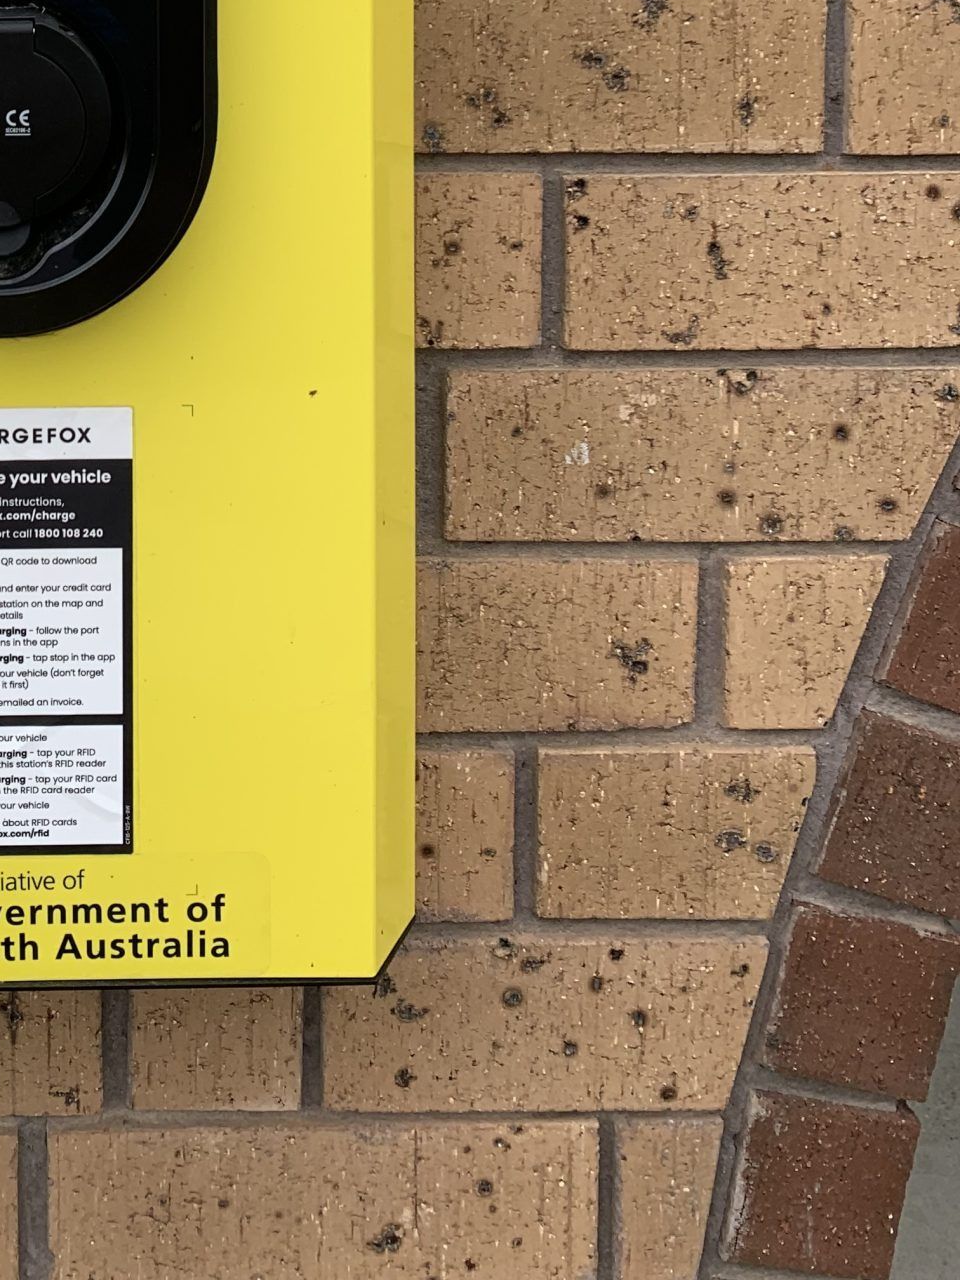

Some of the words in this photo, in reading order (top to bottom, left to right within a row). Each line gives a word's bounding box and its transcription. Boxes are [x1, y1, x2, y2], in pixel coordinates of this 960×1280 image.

[5, 109, 30, 126] CE
[10, 472, 48, 488] your
[52, 470, 112, 484] vehicle
[0, 497, 64, 508] instructions,
[13, 529, 32, 538] call
[34, 529, 60, 538] 1800
[62, 529, 80, 538] 108
[83, 528, 103, 538] 240
[1, 557, 13, 566] QR
[16, 557, 38, 565] code
[41, 557, 50, 565] to
[52, 556, 97, 565] download
[16, 584, 38, 592] enter
[41, 584, 60, 594] your
[62, 583, 88, 592] credit
[90, 583, 111, 592] card
[0, 600, 28, 608] station
[62, 600, 83, 610] map
[86, 599, 103, 607] and
[36, 626, 61, 635] follow
[64, 626, 78, 634] the
[81, 626, 99, 636] port
[14, 638, 21, 646] in
[23, 638, 37, 646] the
[40, 639, 58, 648] app
[33, 654, 48, 663] tap
[50, 654, 69, 662] stop
[72, 653, 79, 661] in
[81, 653, 95, 661] the
[98, 654, 116, 662] app
[16, 669, 48, 678] vehicle
[50, 668, 75, 679] (don't
[78, 668, 104, 678] forget
[1, 680, 7, 688] it
[9, 679, 28, 690] first)
[50, 698, 84, 706] invoice.
[15, 734, 47, 742] vehicle
[37, 749, 52, 758] tap
[55, 750, 74, 759] your
[77, 748, 96, 756] RFID
[16, 760, 52, 768] station's
[55, 760, 74, 768] RFID
[76, 759, 106, 768] reader
[35, 775, 50, 784] tap
[53, 776, 72, 785] your
[75, 774, 94, 782] RFID
[96, 774, 117, 782] card
[4, 786, 18, 794] the
[20, 786, 39, 794] RFID
[42, 786, 62, 794] card
[65, 785, 94, 794] reader
[17, 801, 50, 809] vehicle
[2, 818, 29, 827] about
[32, 818, 50, 826] RFID
[52, 818, 77, 826] cards
[63, 869, 85, 890] of
[186, 894, 226, 922] of
[56, 929, 230, 960] Australia
